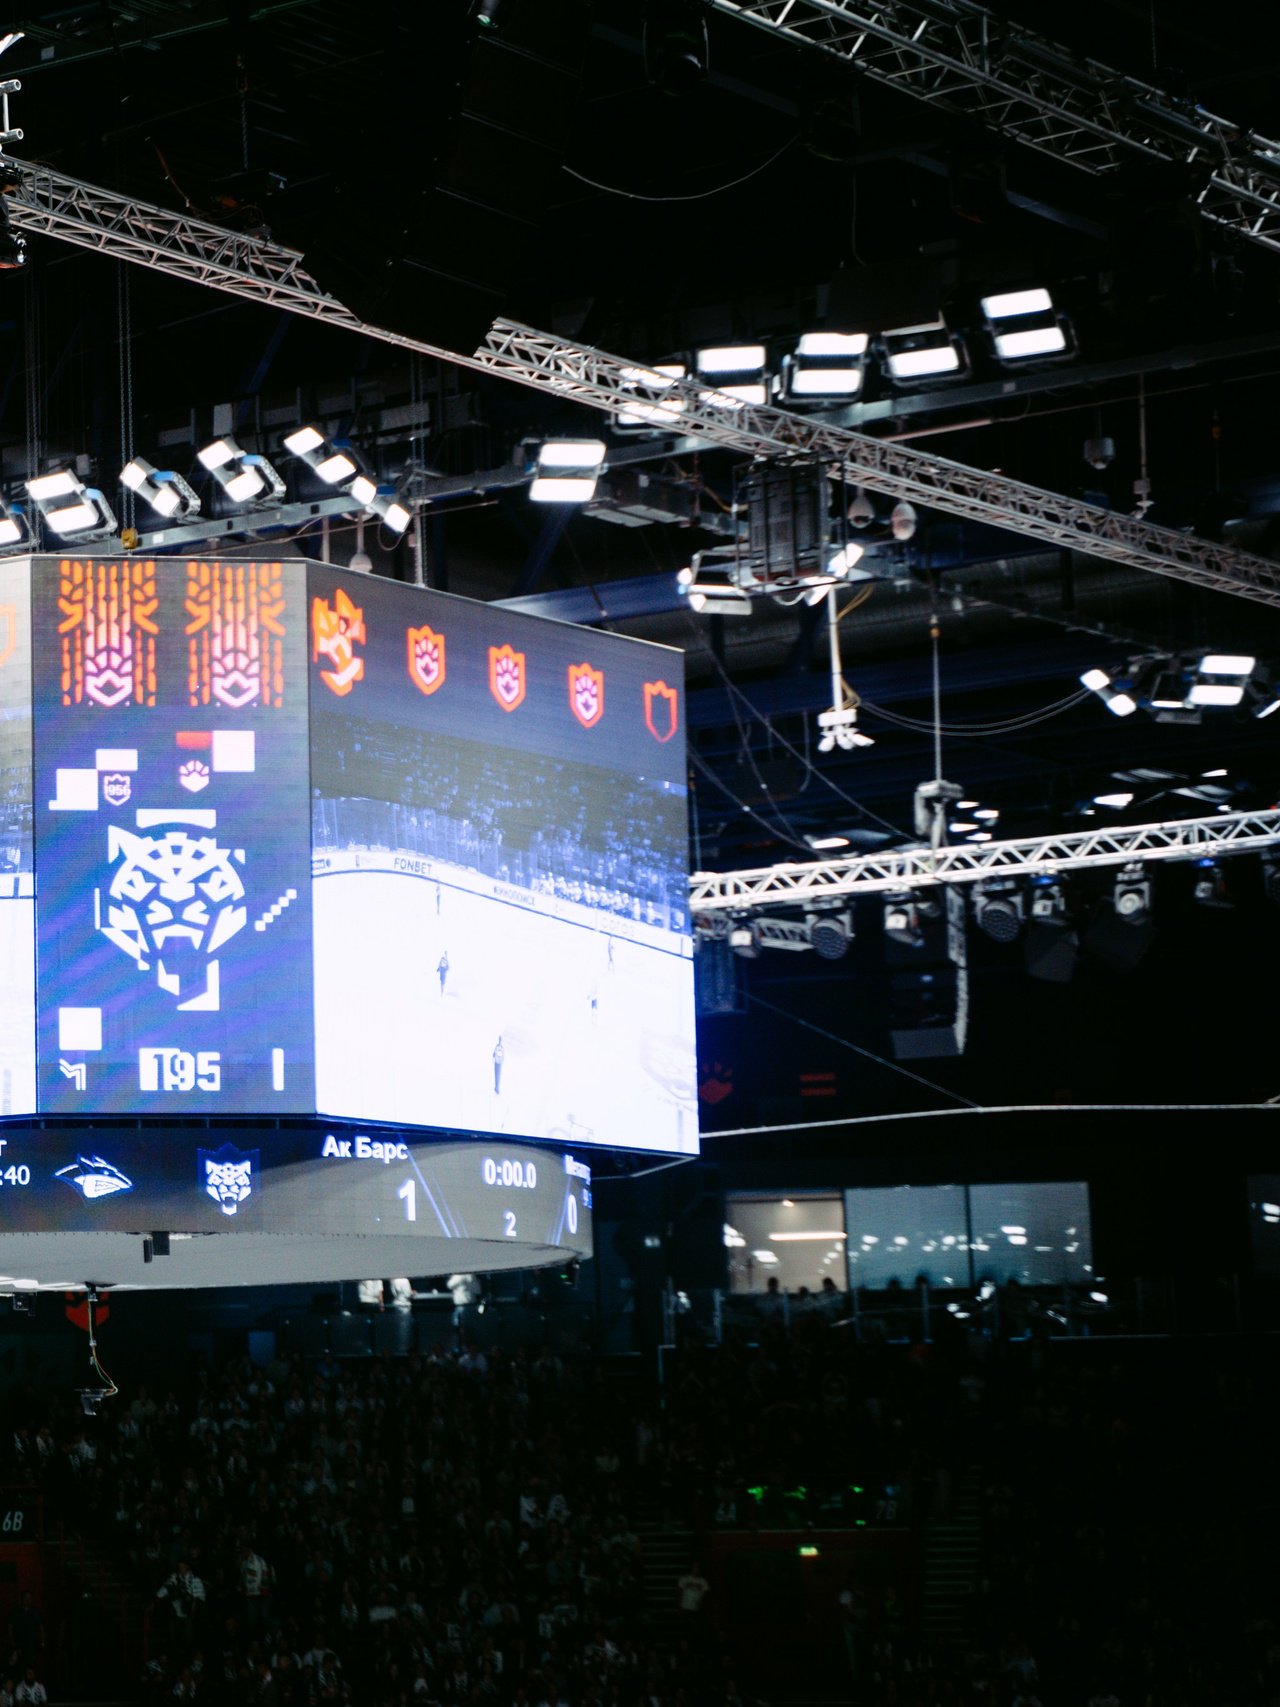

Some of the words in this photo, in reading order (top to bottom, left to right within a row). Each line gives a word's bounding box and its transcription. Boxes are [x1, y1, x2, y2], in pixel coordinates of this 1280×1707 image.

[394, 857, 433, 876] FONBET
[322, 1136, 352, 1159] Ак
[355, 1137, 409, 1164] Барс
[483, 1157, 537, 1189] 0:00.0
[399, 1179, 416, 1222] 1
[503, 1211, 517, 1237] 2
[1, 1510, 24, 1533] 6B
